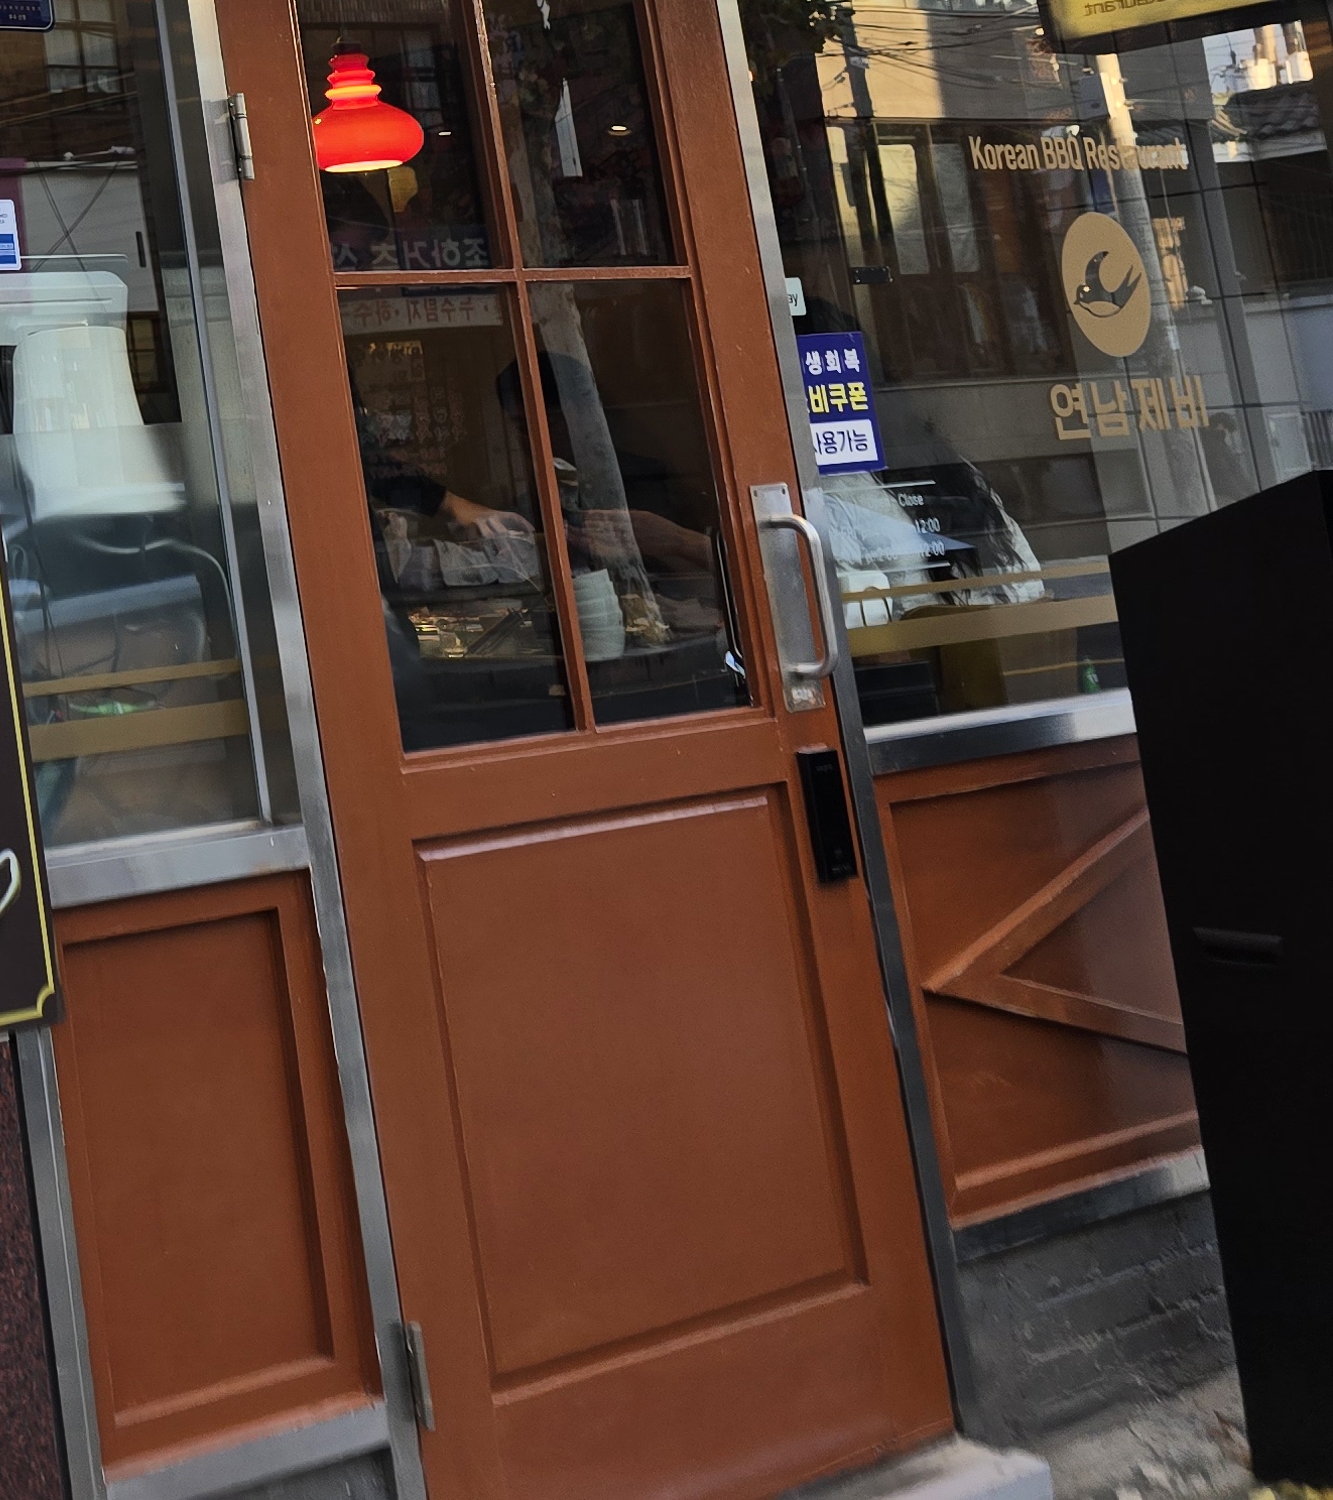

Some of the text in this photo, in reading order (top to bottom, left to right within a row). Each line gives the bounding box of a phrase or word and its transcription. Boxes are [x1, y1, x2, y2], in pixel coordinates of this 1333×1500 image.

[968, 135, 1041, 171] Korean
[1040, 136, 1085, 171] BBQ
[805, 348, 860, 375] 생회복
[806, 381, 869, 414] 비쿠폰
[1050, 375, 1209, 441] 연남제비
[898, 493, 925, 507] Close
[914, 517, 941, 534] 12:00
